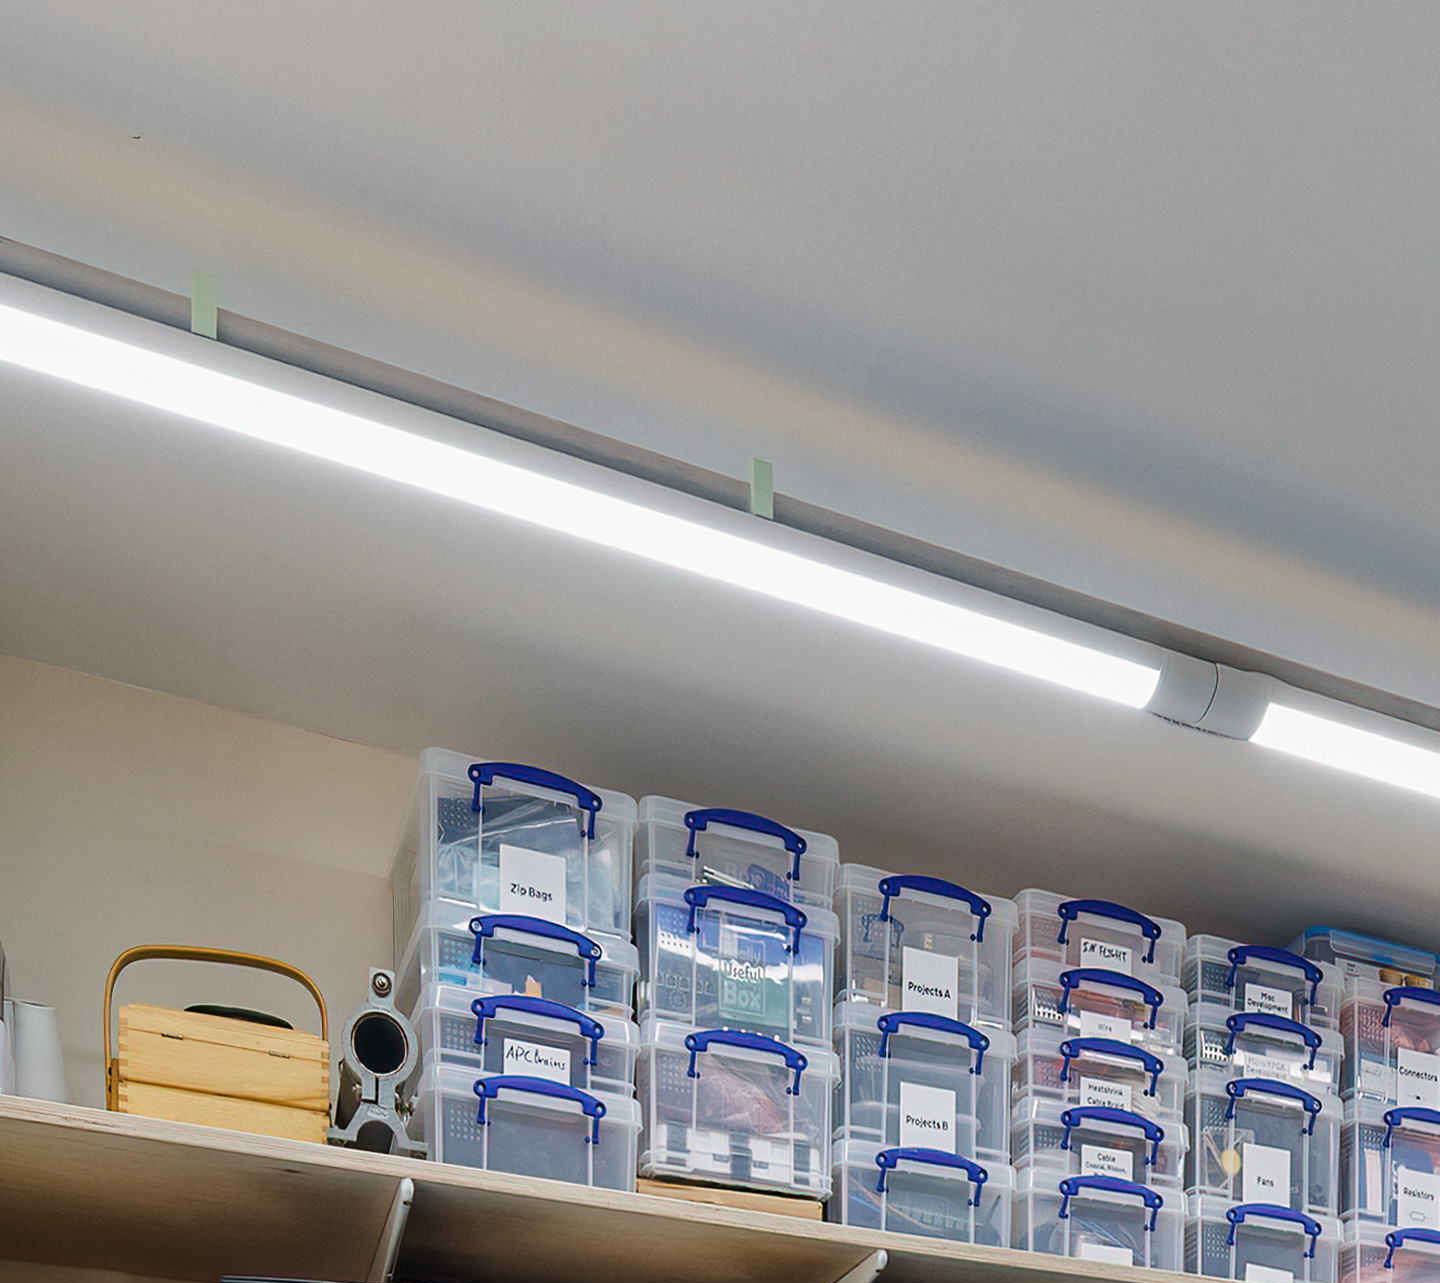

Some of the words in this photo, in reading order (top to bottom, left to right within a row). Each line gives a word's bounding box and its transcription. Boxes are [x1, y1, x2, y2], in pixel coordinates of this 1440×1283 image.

[511, 884, 527, 896] Zip
[529, 887, 553, 902] Bags
[725, 961, 763, 980] Useful
[725, 982, 760, 1008] Box
[908, 981, 942, 997] Projects
[944, 989, 951, 998] A
[1261, 992, 1275, 1002] Misc
[1247, 997, 1288, 1013] Development
[1398, 1066, 1438, 1083] Connectors
[1088, 1083, 1124, 1097] Heatshrink
[906, 1115, 941, 1130] Projects
[942, 1121, 949, 1131] B
[1097, 1153, 1116, 1163] Cable
[1257, 1176, 1274, 1187] Fans
[1403, 1187, 1435, 1201] Resistors
